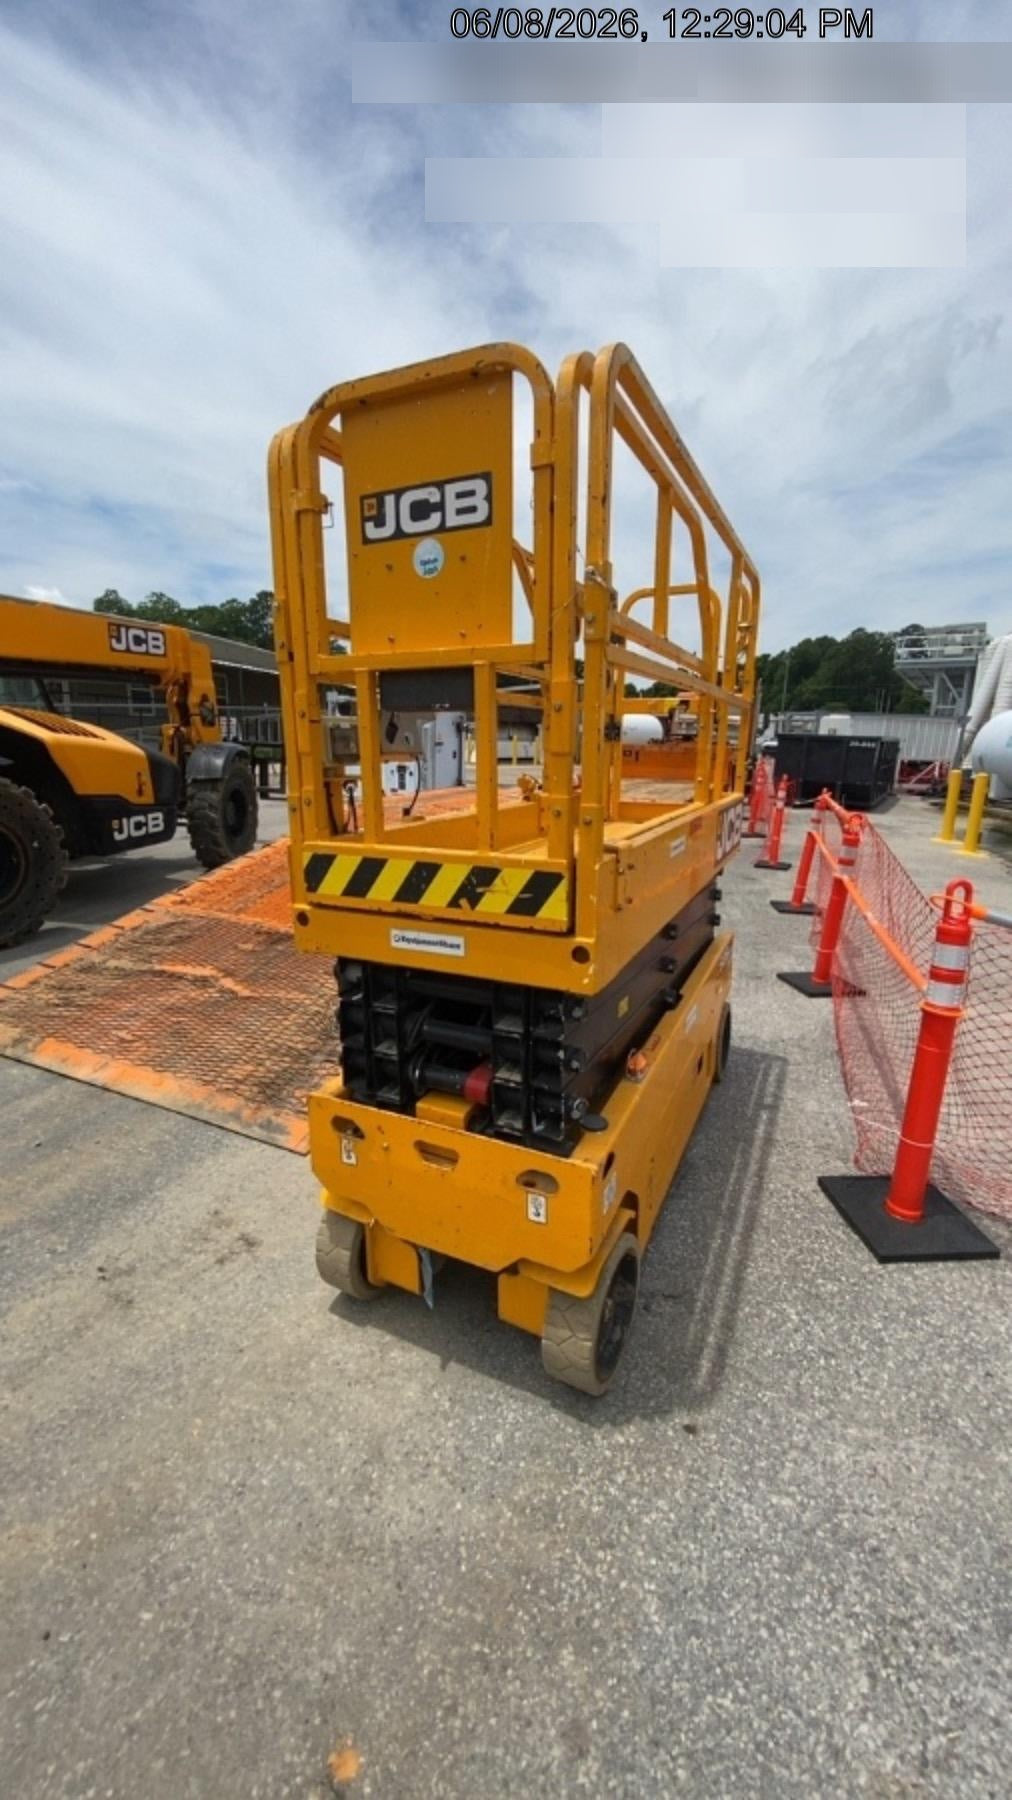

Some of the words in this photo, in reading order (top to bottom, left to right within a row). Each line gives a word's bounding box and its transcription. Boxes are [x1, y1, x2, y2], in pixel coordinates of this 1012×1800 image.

[364, 479, 489, 539] JCB
[111, 626, 165, 655] JCB
[113, 813, 164, 841] JCB
